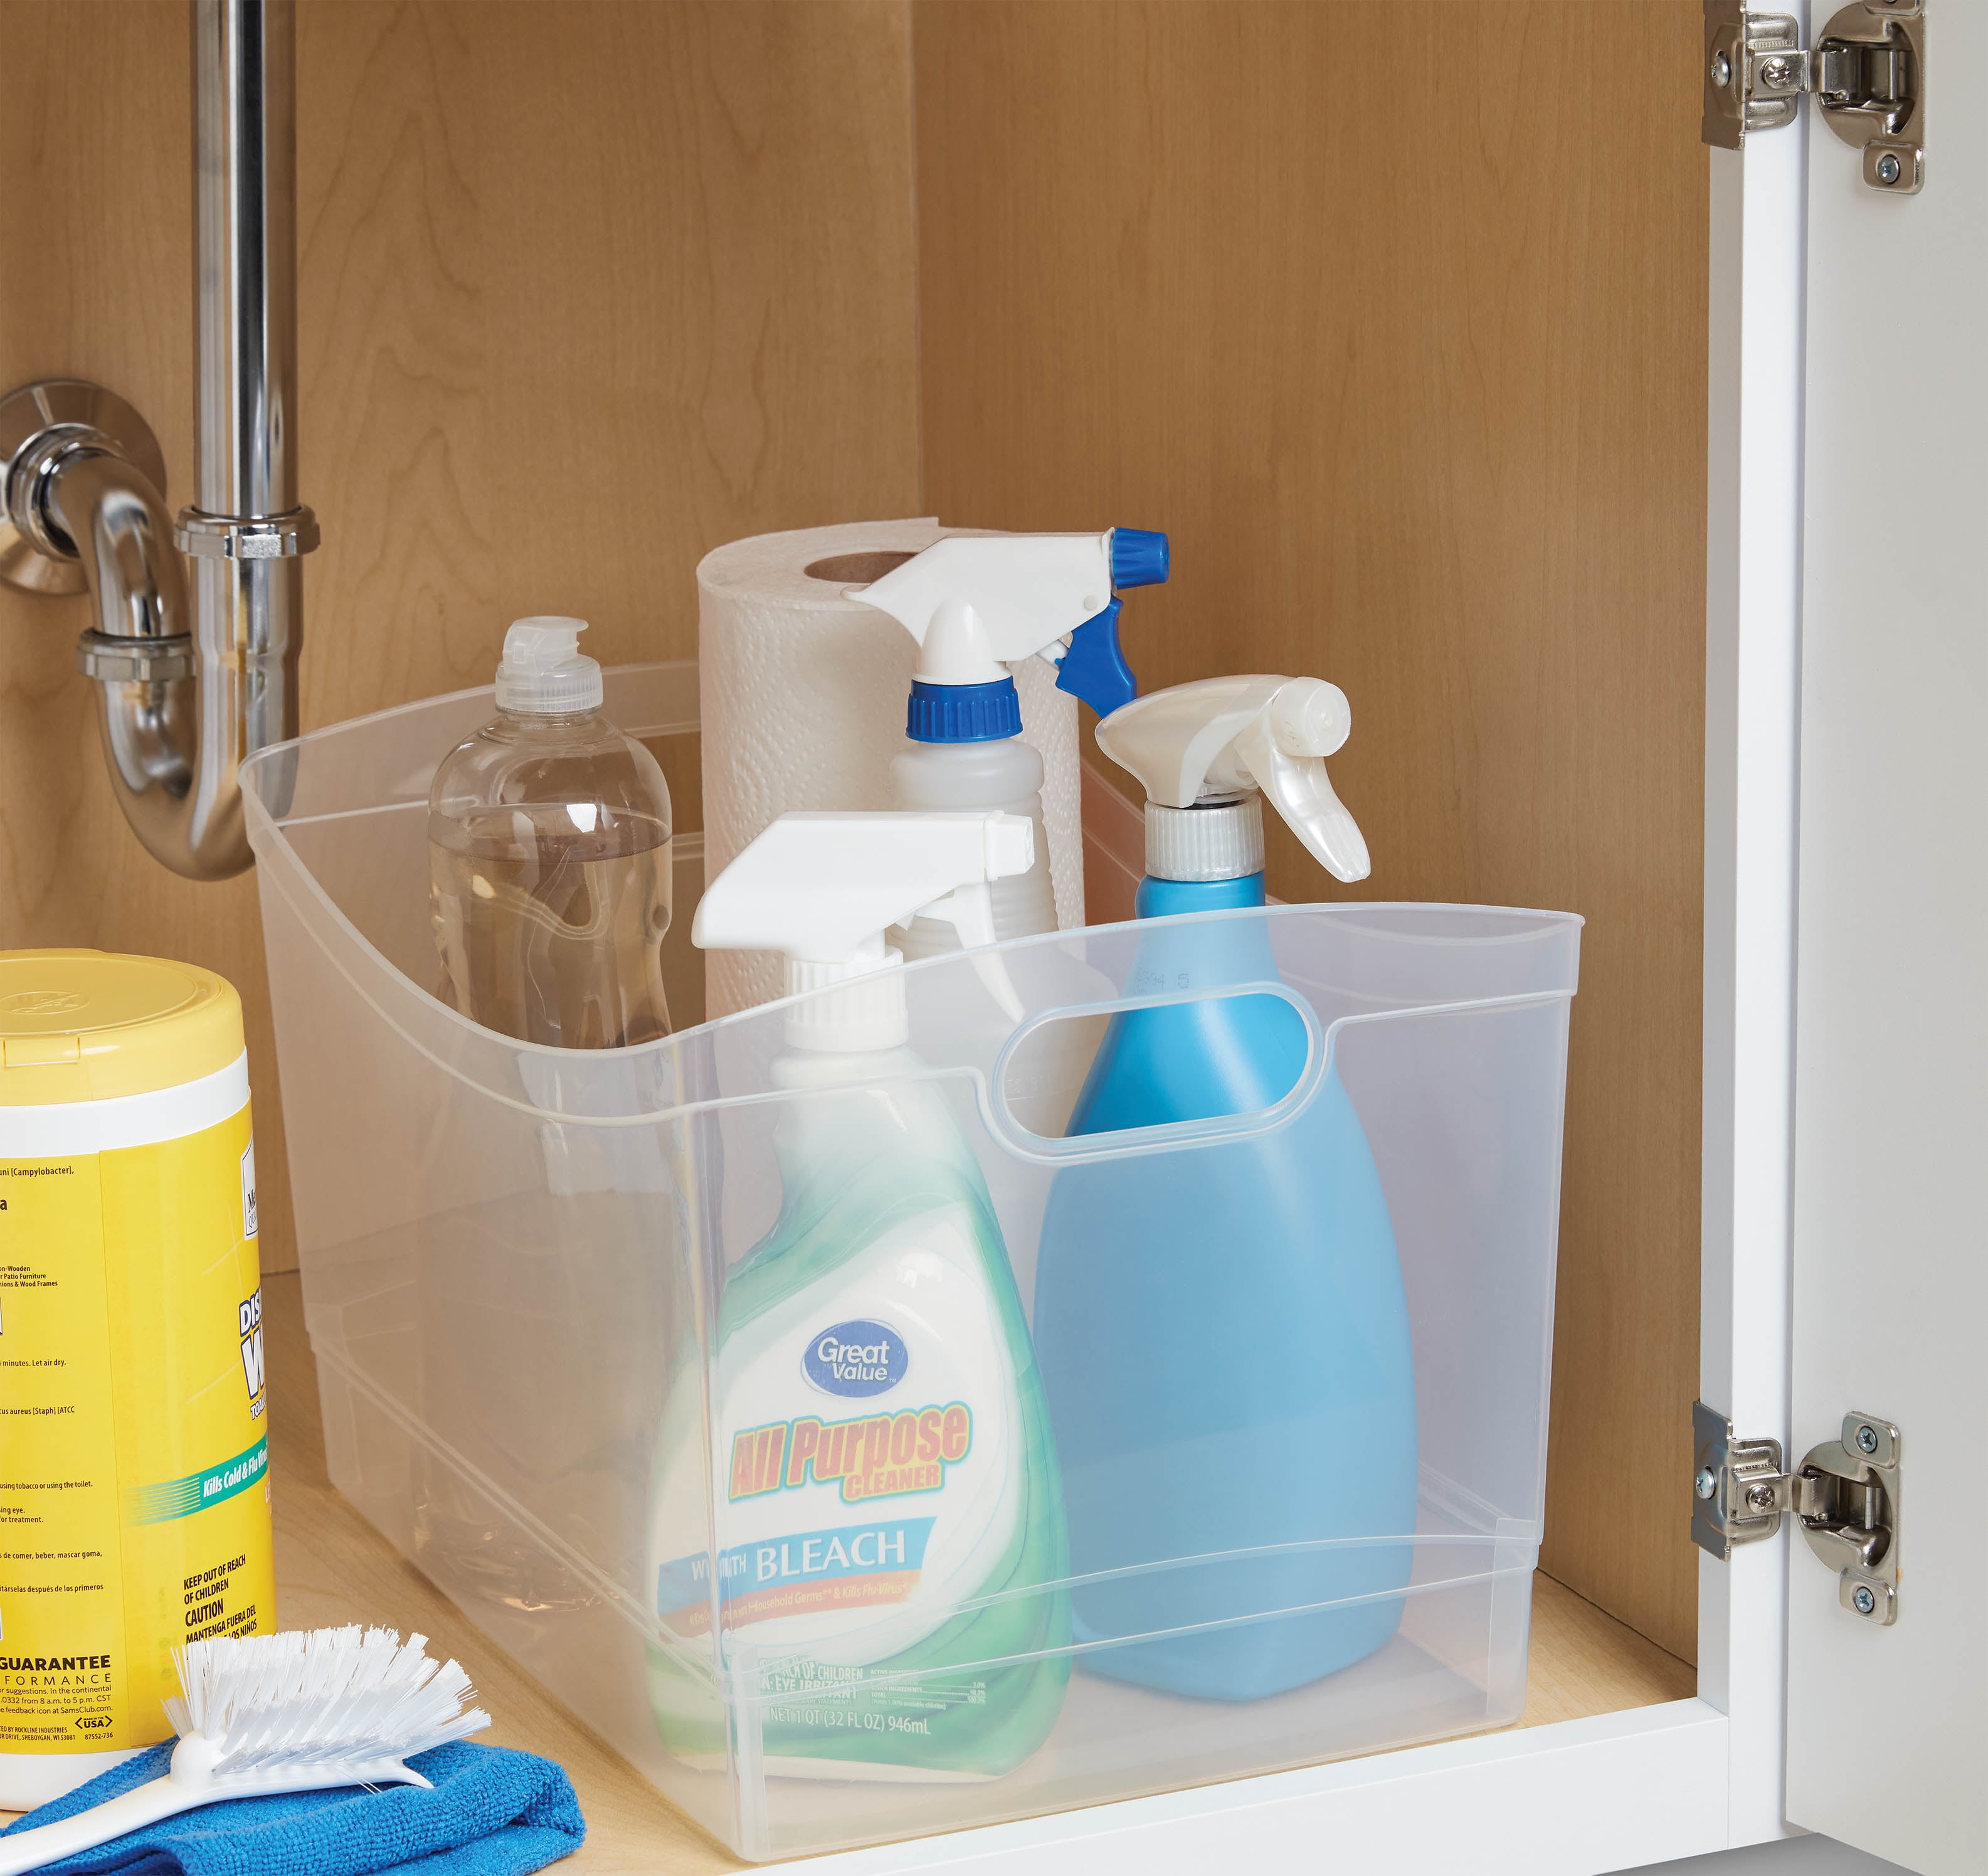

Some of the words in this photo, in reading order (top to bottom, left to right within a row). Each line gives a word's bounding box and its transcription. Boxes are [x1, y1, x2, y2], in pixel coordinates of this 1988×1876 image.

[11, 1165, 75, 1177] [Campylobacter],
[817, 1337, 890, 1365] Great
[53, 1359, 66, 1367] dry.
[832, 1362, 888, 1382] Value
[33, 1407, 56, 1416] [Staph]
[58, 1406, 75, 1415] [ATCC
[730, 1426, 785, 1498] All
[788, 1406, 968, 1485] Purpose
[0, 1482, 15, 1490] using
[46, 1482, 63, 1490] using
[203, 1475, 223, 1498] Kills
[223, 1464, 241, 1488] Cold
[241, 1461, 248, 1480] &
[248, 1456, 258, 1476] Flu
[845, 1464, 940, 1499] CLEANER
[82, 1551, 102, 1559] goma,
[756, 1530, 906, 1582] BLEACH
[184, 1574, 202, 1591] KEEP
[204, 1567, 218, 1583] OUT
[218, 1564, 226, 1577] OF
[228, 1553, 246, 1573] REACH
[28, 1585, 53, 1594] después
[75, 1584, 103, 1593] primeros
[184, 1592, 194, 1605] OF
[195, 1577, 229, 1601] CHILDREN
[749, 1594, 793, 1614] Household
[833, 1587, 842, 1599] &
[842, 1584, 862, 1599] Kills
[862, 1582, 877, 1597] Flu
[185, 1598, 224, 1627] CAUTION
[186, 1620, 226, 1645] MANTENGA
[226, 1610, 246, 1630] FUERA
[247, 1604, 256, 1619] DEL
[230, 1629, 240, 1640] OS
[240, 1618, 257, 1636] NIÑOS
[0, 1655, 111, 1671] GUARANTEE
[801, 1661, 816, 1680] OF
[817, 1665, 864, 1680] CHILDREN
[6, 1687, 48, 1695] suggestions.
[71, 1685, 112, 1694] continental
[775, 1675, 796, 1692] EYE
[6, 1706, 35, 1714] feedback
[61, 1705, 113, 1714] SamsClub.com.
[83, 1720, 105, 1729] USA
[769, 1707, 791, 1723] NET
[795, 1709, 801, 1724] 1
[805, 1710, 820, 1726] QT
[823, 1709, 844, 1728] (32
[847, 1712, 862, 1729] FL
[864, 1713, 885, 1733] OZ)
[887, 1715, 931, 1736] 946mL
[85, 1732, 114, 1741] 87552-736
